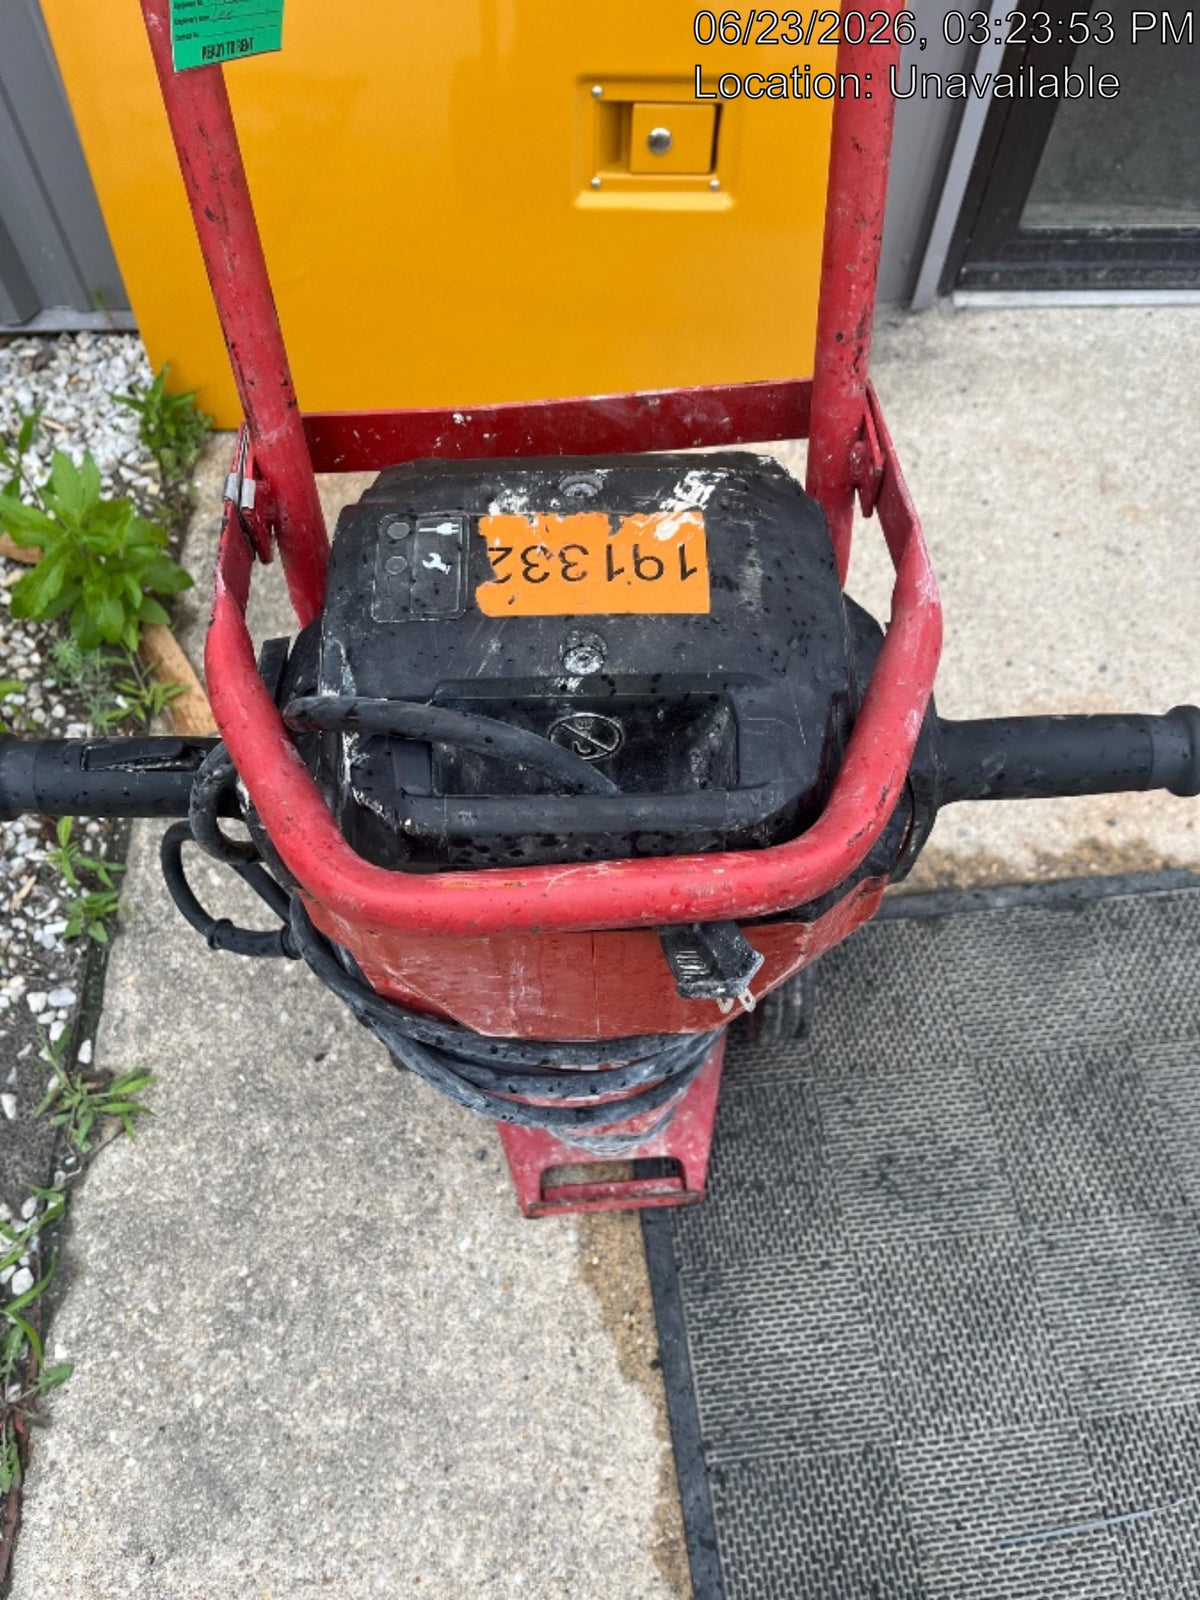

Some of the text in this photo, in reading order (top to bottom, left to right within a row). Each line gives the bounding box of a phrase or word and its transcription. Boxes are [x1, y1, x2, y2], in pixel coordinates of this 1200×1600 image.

[202, 37, 255, 60] READY TO RENT
[488, 543, 698, 585] 191332
